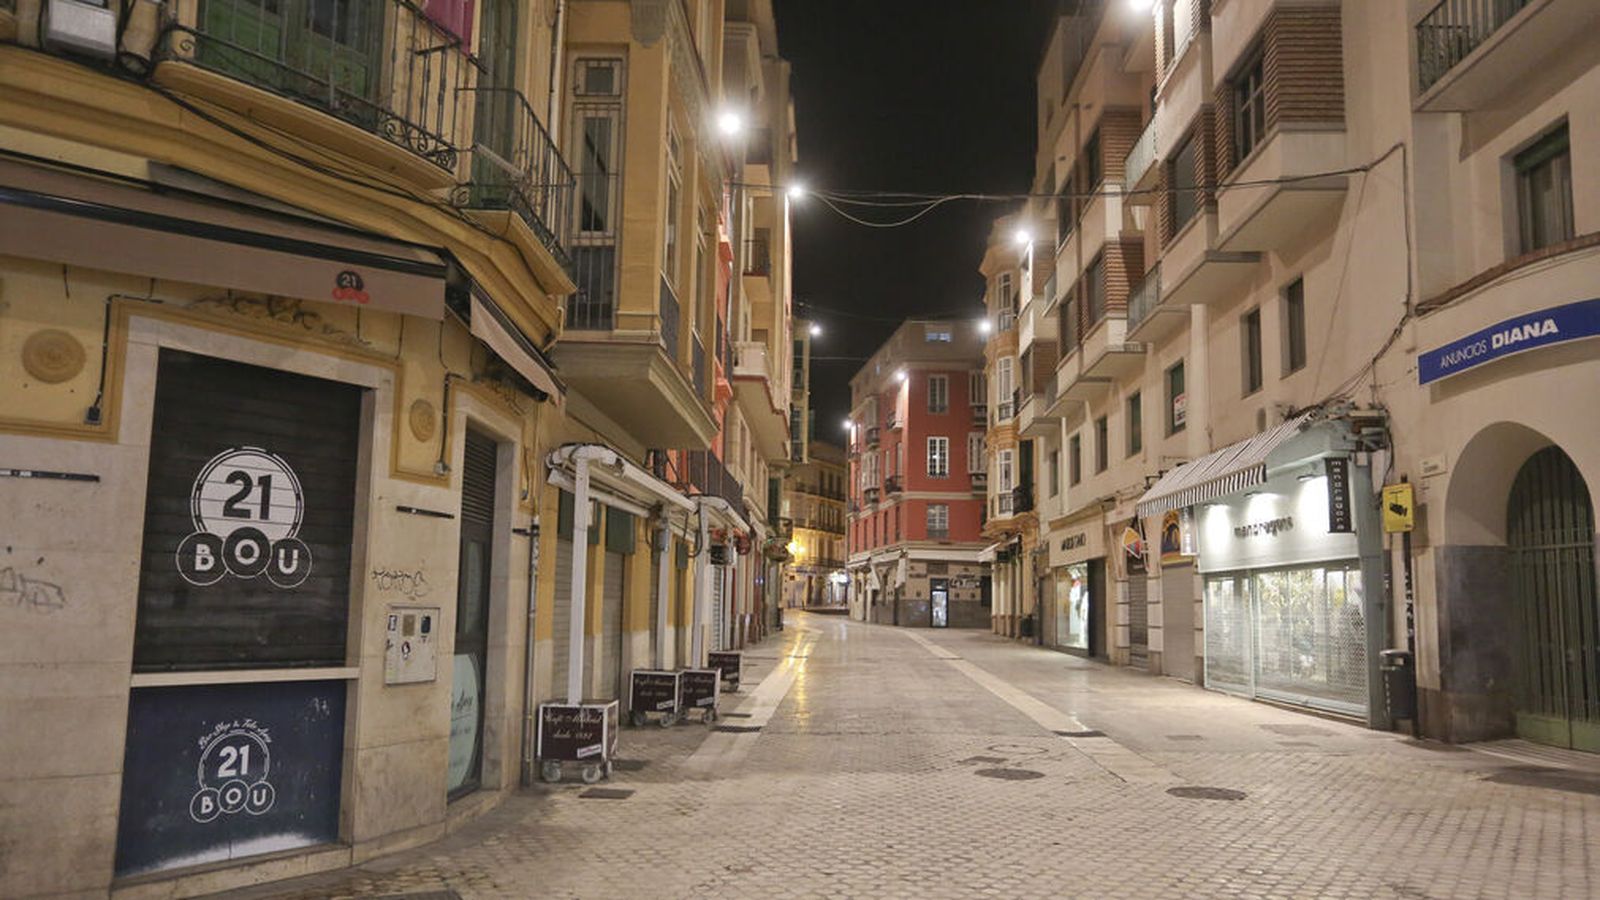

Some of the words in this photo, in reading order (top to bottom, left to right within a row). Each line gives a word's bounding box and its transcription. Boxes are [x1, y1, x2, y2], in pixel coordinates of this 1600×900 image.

[342, 273, 357, 288] 21
[1440, 339, 1487, 369] ANUNCIOS
[1491, 318, 1559, 349] DIANA
[223, 470, 272, 520] 21
[194, 538, 299, 575] BOU
[218, 745, 249, 778] 21
[201, 788, 267, 815] BOU
